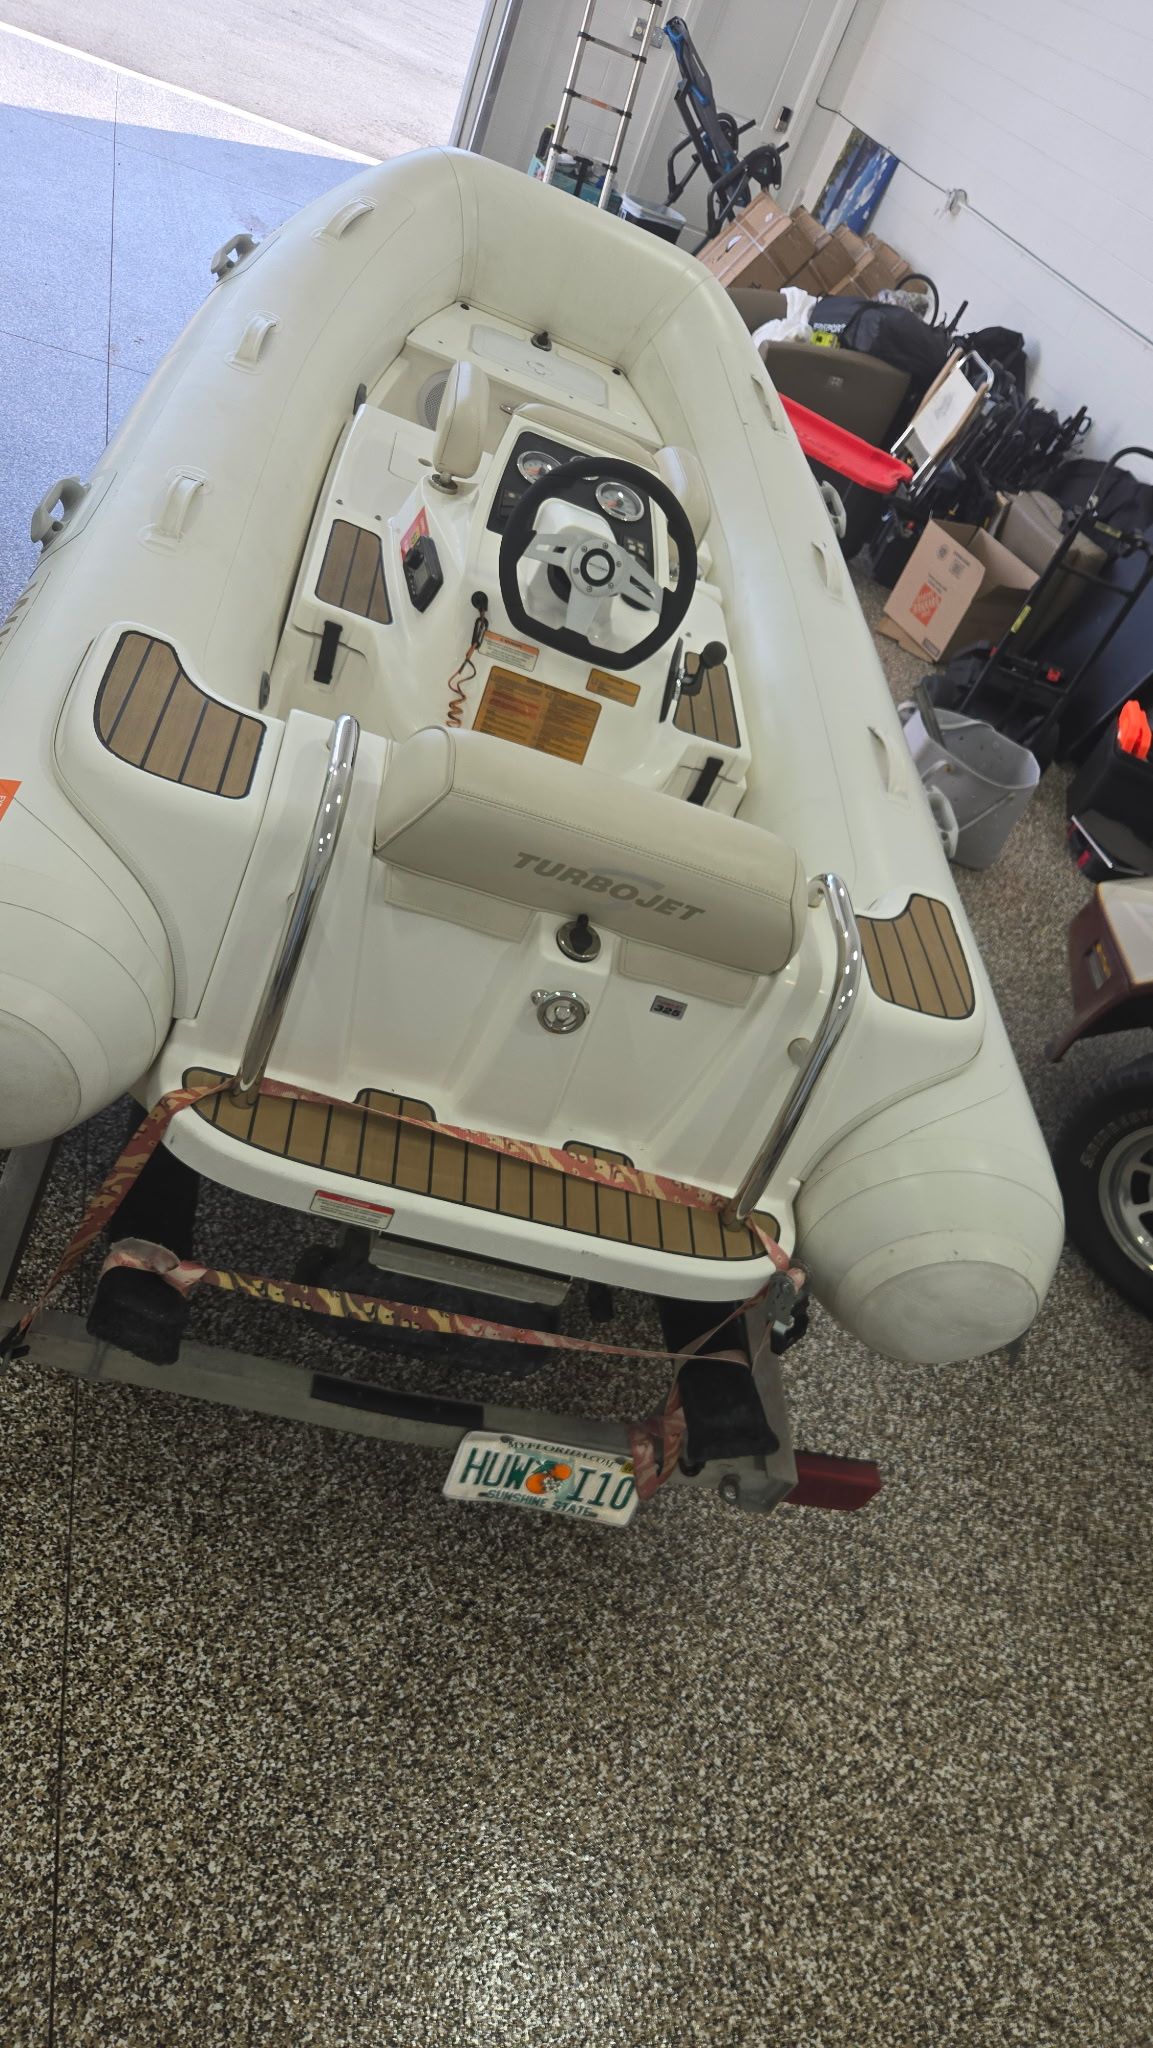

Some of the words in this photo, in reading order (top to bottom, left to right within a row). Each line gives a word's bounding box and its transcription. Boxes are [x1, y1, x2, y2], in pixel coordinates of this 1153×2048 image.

[513, 851, 706, 921] TURBOJET
[459, 1447, 534, 1491] HUW
[487, 1488, 548, 1507] SUNSHINE
[552, 1500, 593, 1518] STATE
